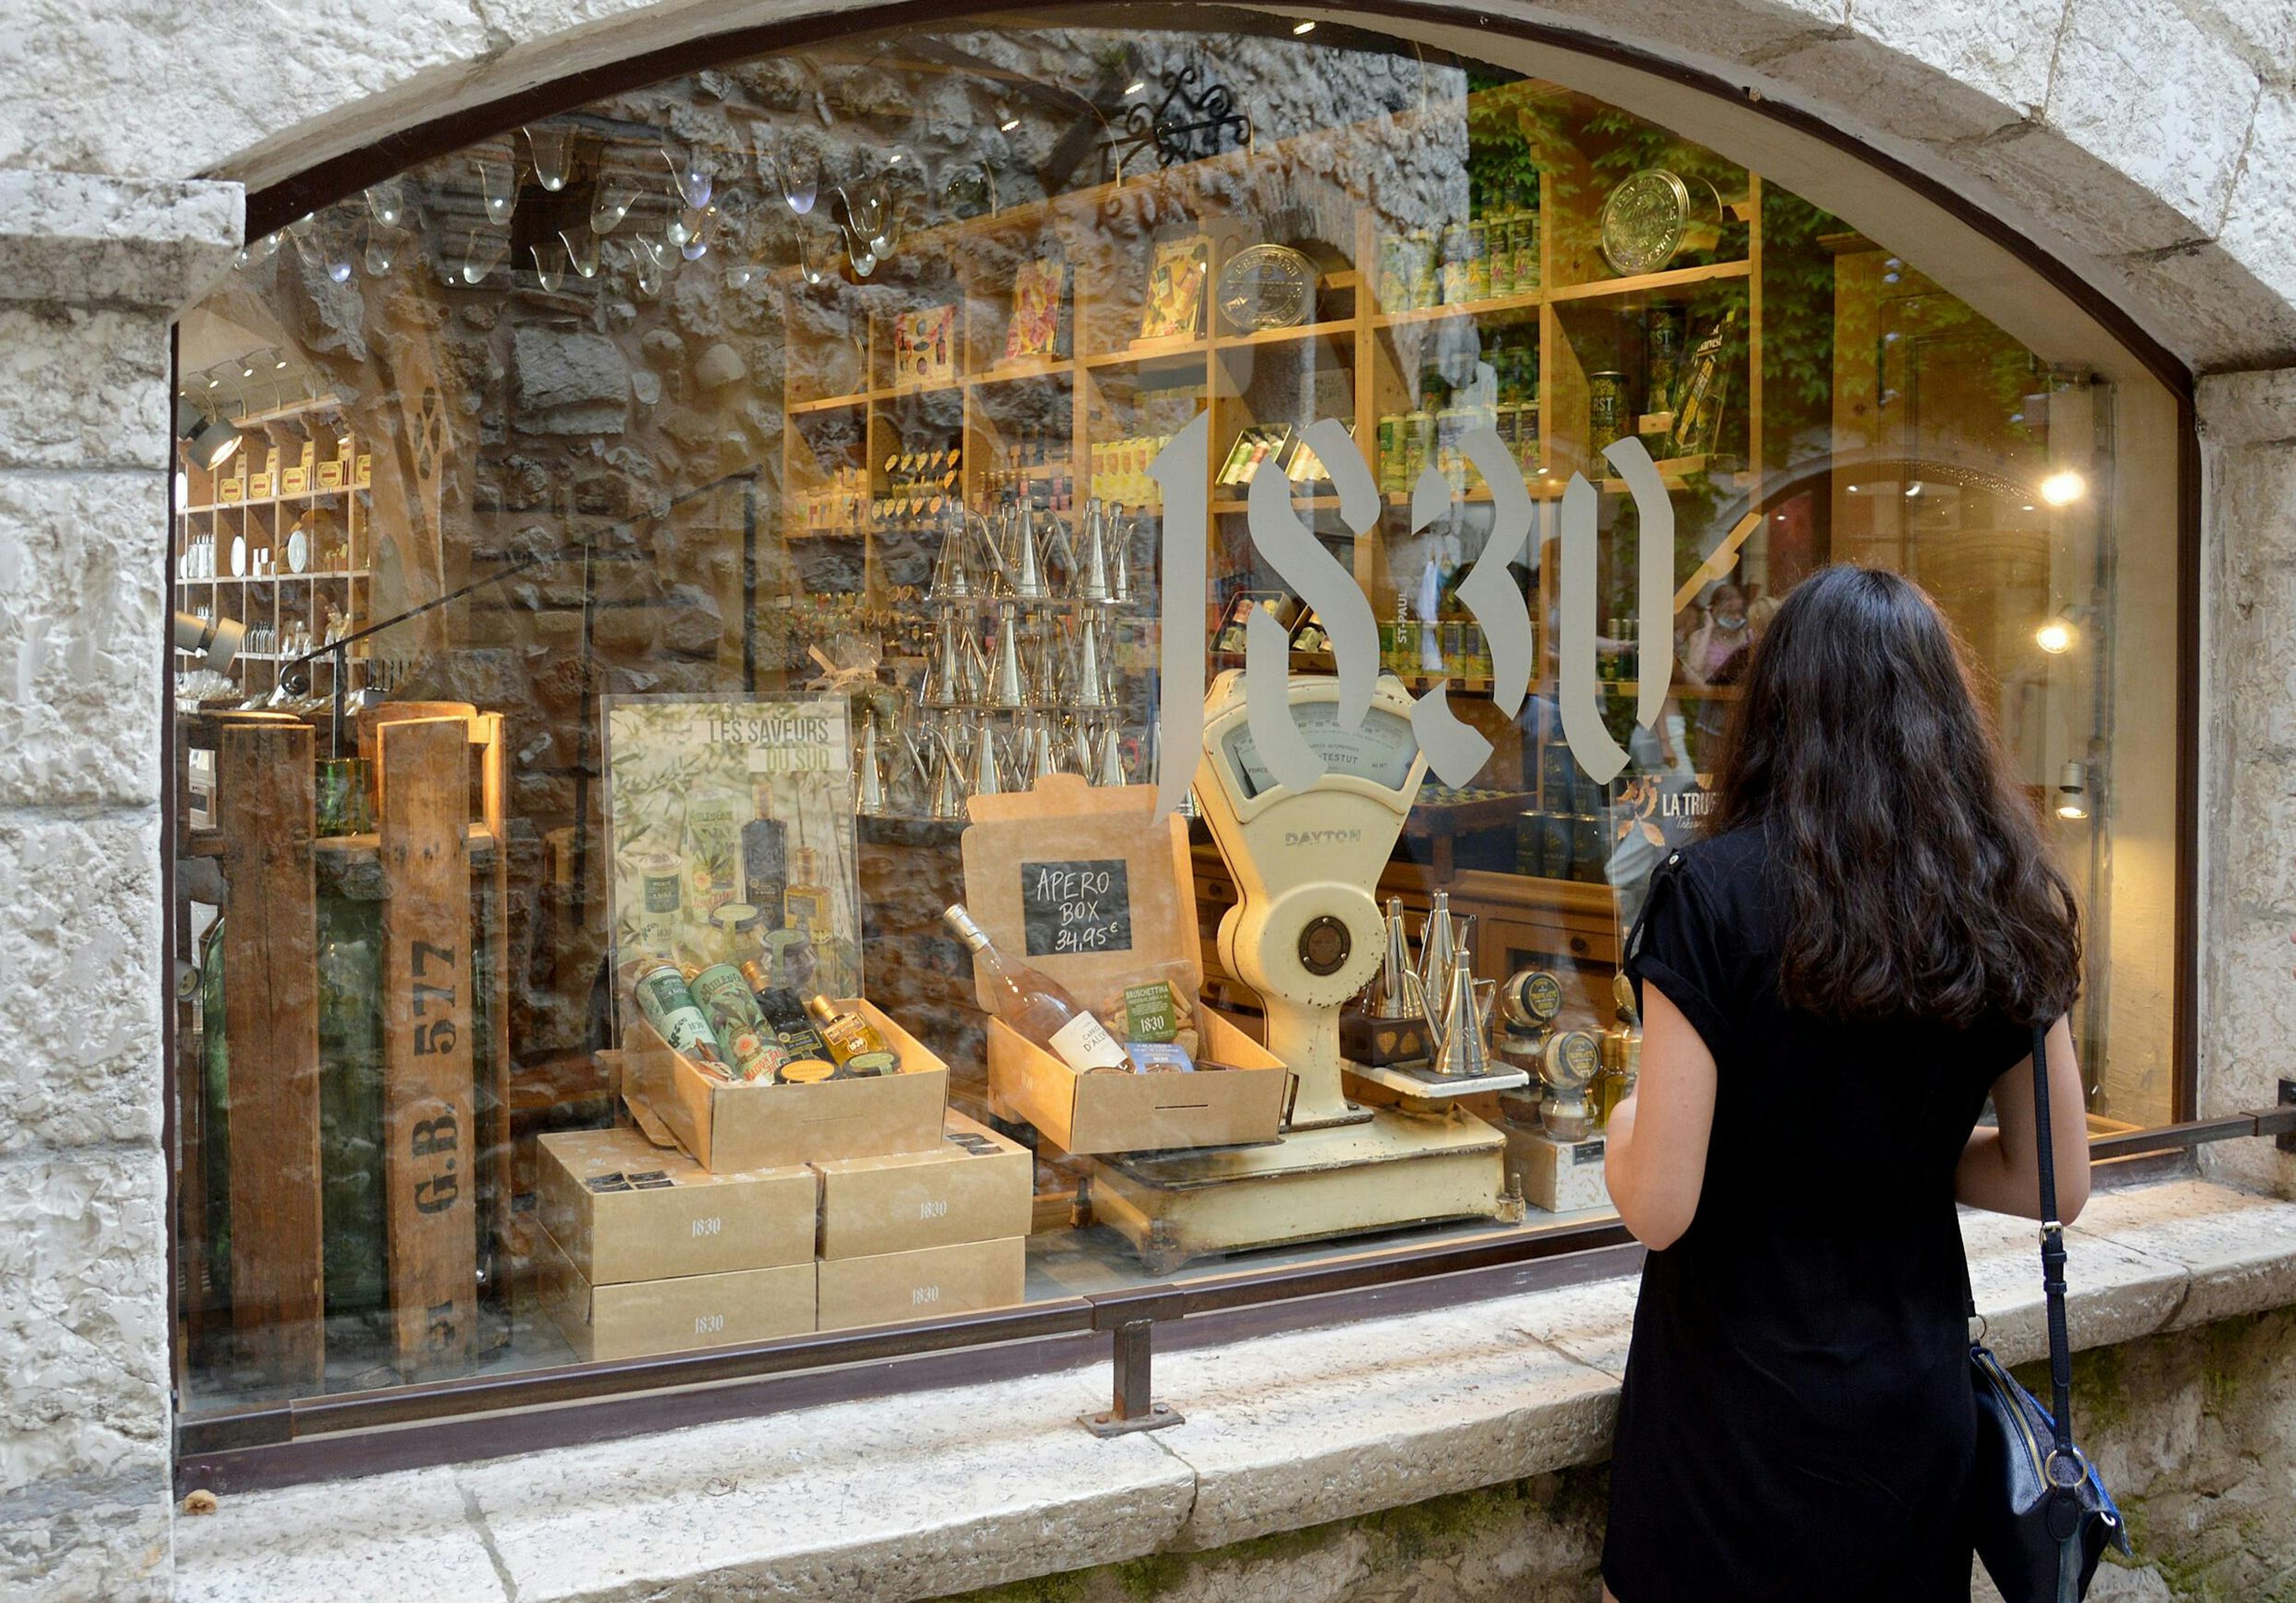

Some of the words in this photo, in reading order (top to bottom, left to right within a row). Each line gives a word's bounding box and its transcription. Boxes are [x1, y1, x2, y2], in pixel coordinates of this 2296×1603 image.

[1145, 409, 1674, 827] 1830
[1398, 591, 1409, 643] ST-PAUL
[710, 719, 742, 744] LES
[747, 717, 829, 743] SAVEURS
[766, 749, 790, 770] DU
[795, 749, 830, 770] SUD
[1663, 793, 1680, 817] LA
[1285, 829, 1361, 847] DAYTON
[1036, 868, 1110, 901] APERO
[1059, 900, 1100, 927] BOX
[412, 941, 457, 1057] 577
[1140, 1015, 1164, 1034] 1830
[412, 1101, 458, 1214] G.B.
[921, 1201, 947, 1219] 1830
[692, 1217, 722, 1237] 1830
[912, 1285, 939, 1306] 1830
[695, 1314, 723, 1335] 1830
